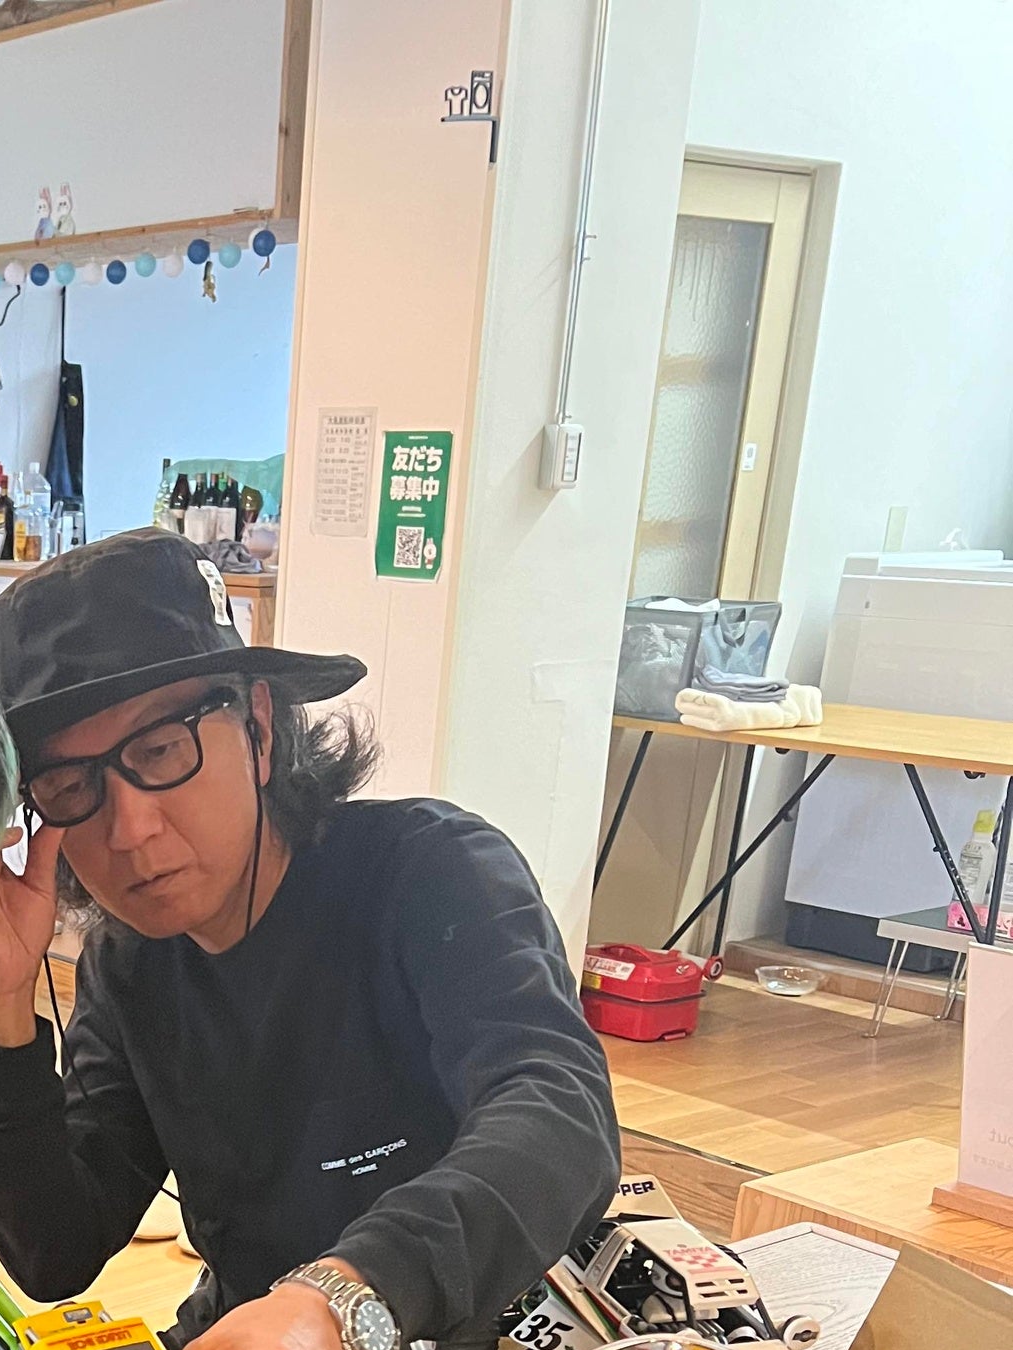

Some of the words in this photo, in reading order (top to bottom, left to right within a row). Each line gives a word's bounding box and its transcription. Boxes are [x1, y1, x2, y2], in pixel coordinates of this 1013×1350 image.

[392, 445, 443, 472] 友だち
[390, 475, 440, 502] 募集中
[663, 1245, 716, 1256] TAMIYA
